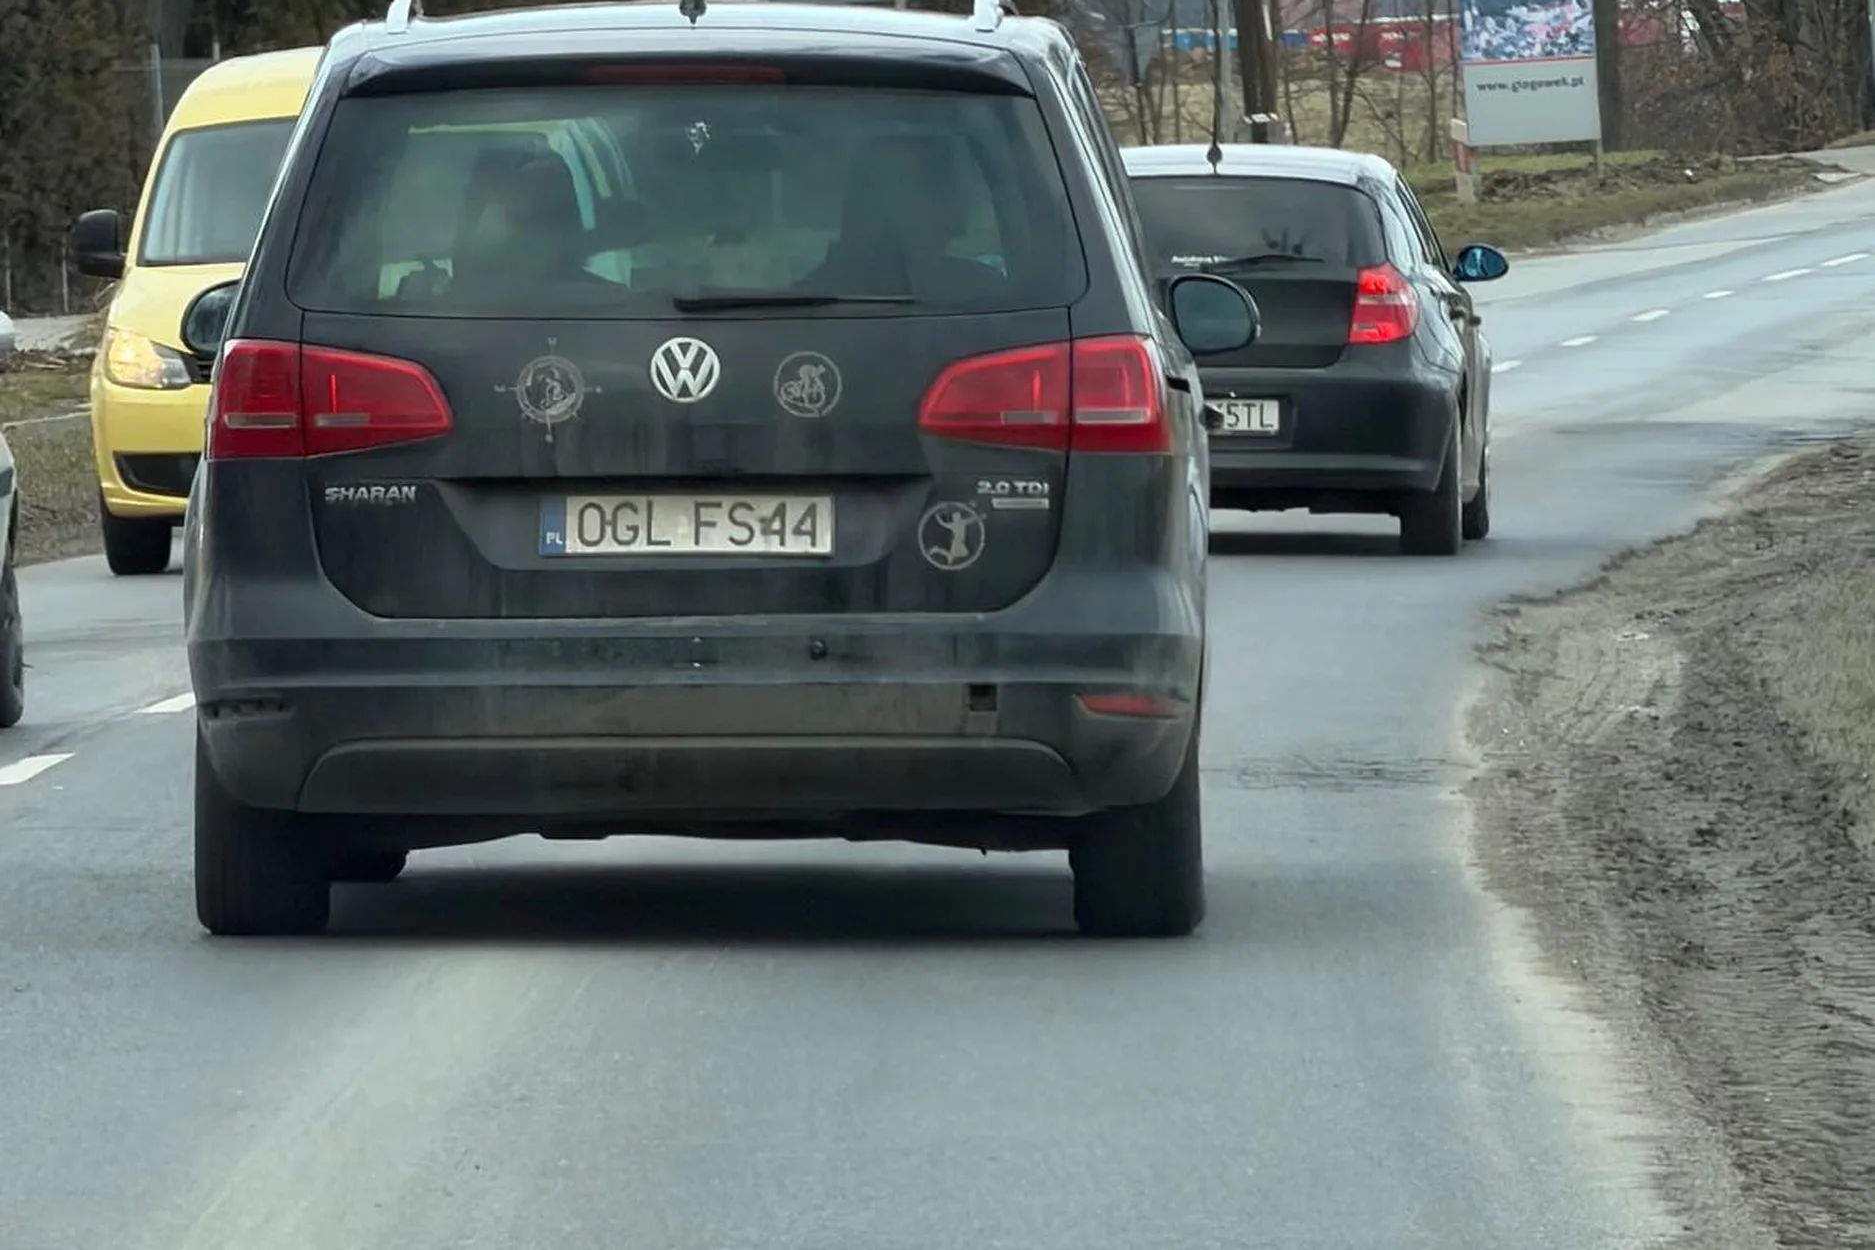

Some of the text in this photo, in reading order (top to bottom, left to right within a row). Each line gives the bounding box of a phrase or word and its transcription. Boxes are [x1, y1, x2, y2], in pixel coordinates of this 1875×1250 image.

[1218, 402, 1275, 428] 5TL
[324, 485, 417, 502] SHARAN
[1013, 480, 1049, 494] TDI
[577, 501, 818, 548] OGL FS44
[545, 532, 564, 545] PL
